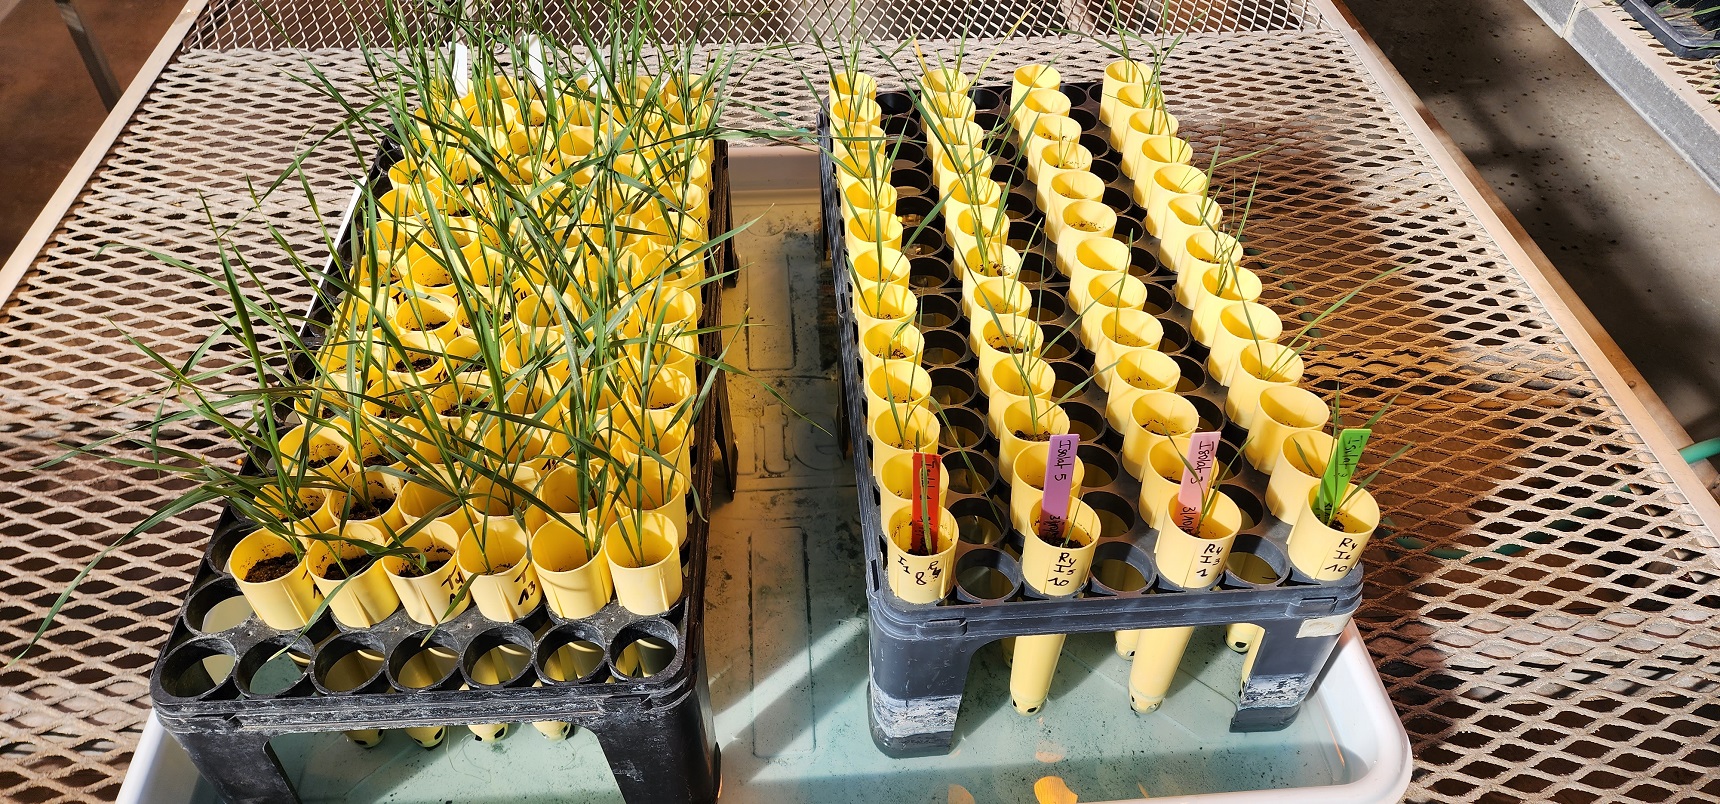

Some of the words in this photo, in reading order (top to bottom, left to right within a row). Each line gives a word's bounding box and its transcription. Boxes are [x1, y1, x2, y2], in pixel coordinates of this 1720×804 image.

[1054, 440, 1072, 469] Isolat
[1194, 440, 1215, 474] Isolat
[1054, 473, 1067, 482] 5
[1057, 552, 1078, 569] Ry
[1324, 563, 1348, 573] 10
[915, 571, 928, 586] 8
[1047, 577, 1070, 587] 10
